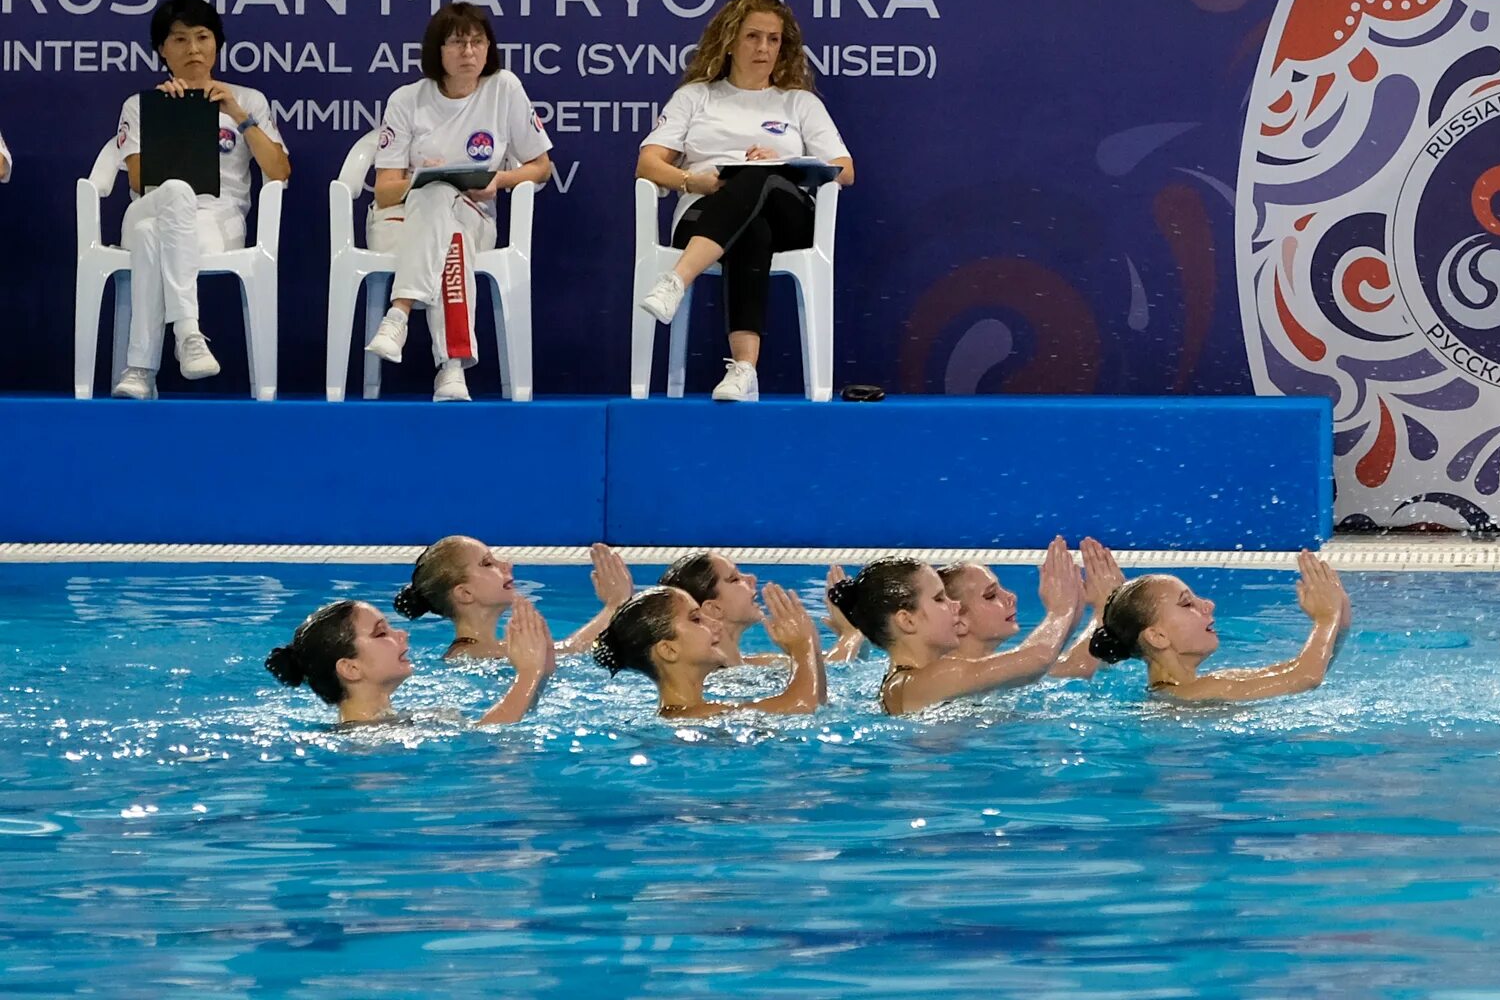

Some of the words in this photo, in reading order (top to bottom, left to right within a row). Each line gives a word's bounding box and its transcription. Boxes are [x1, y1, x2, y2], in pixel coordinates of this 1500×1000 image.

[3, 40, 353, 74] INTERNIONAL
[368, 42, 561, 75] ARTIC
[577, 42, 938, 80] (SYNCNISED)
[445, 243, 464, 304] RUSSIA
